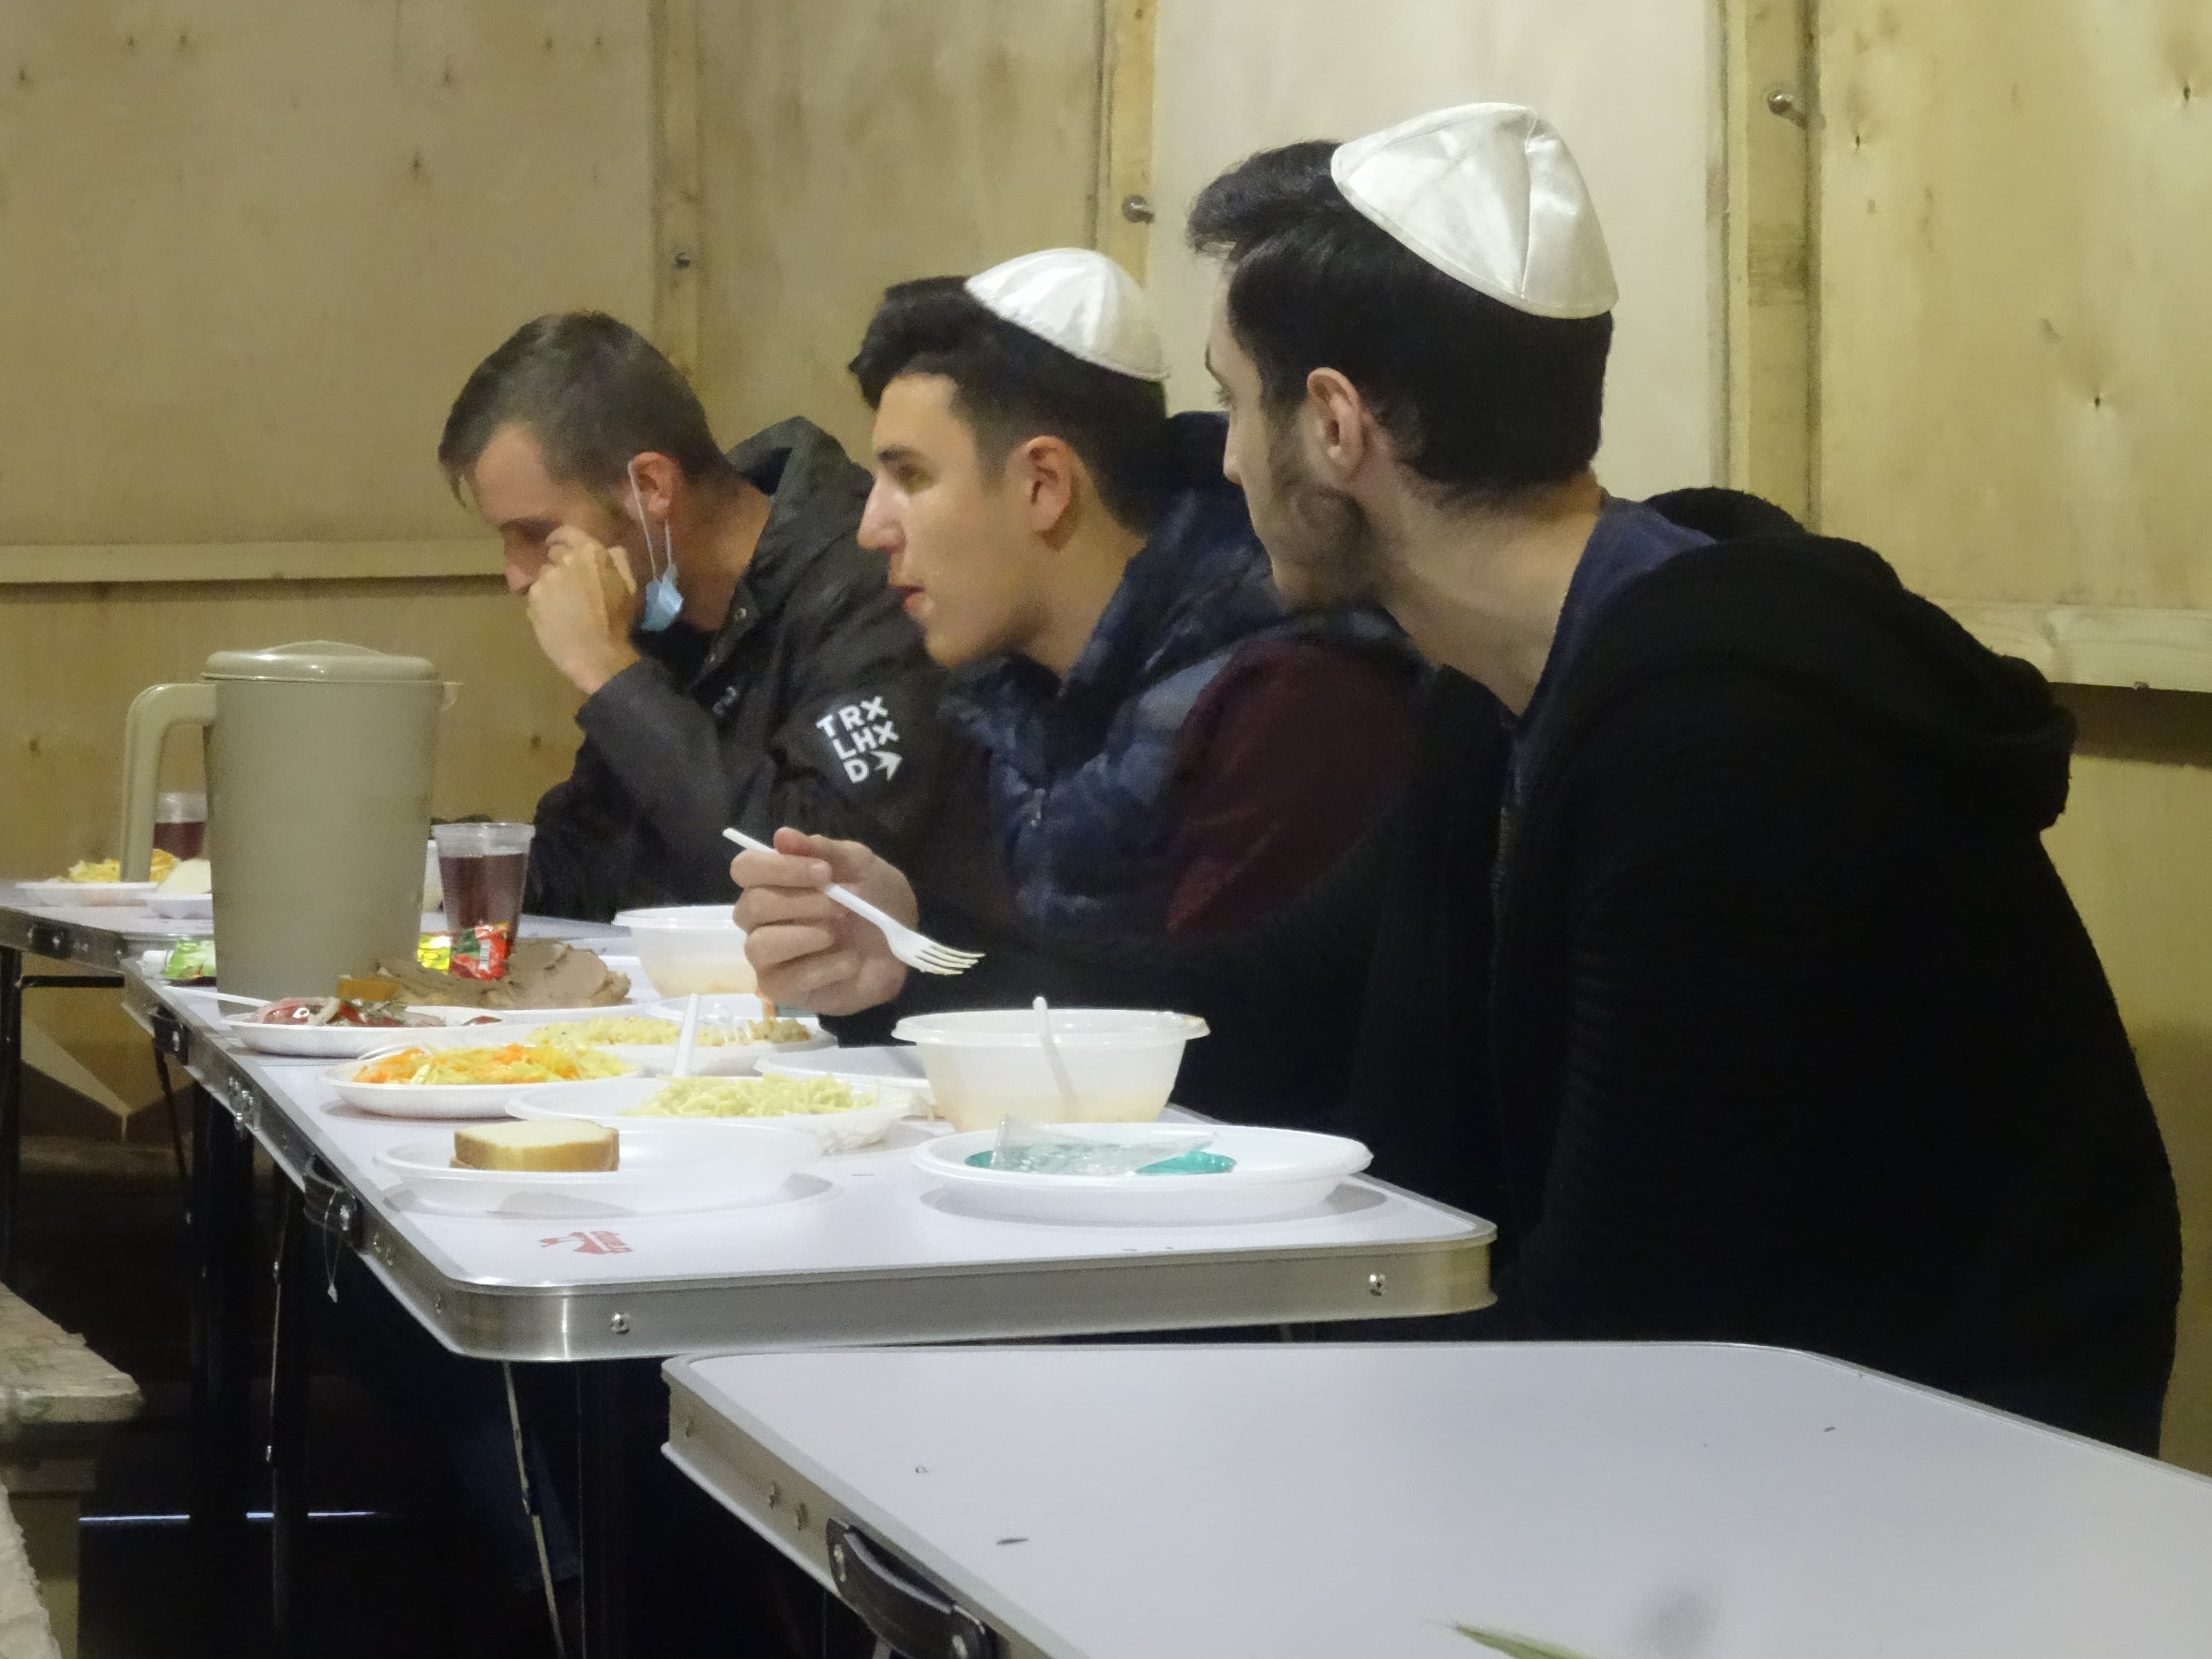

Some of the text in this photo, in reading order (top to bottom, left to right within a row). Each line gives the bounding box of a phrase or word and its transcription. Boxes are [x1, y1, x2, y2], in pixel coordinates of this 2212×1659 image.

[815, 696, 888, 737] TRX
[832, 720, 899, 760] LHX
[843, 759, 869, 783] D
